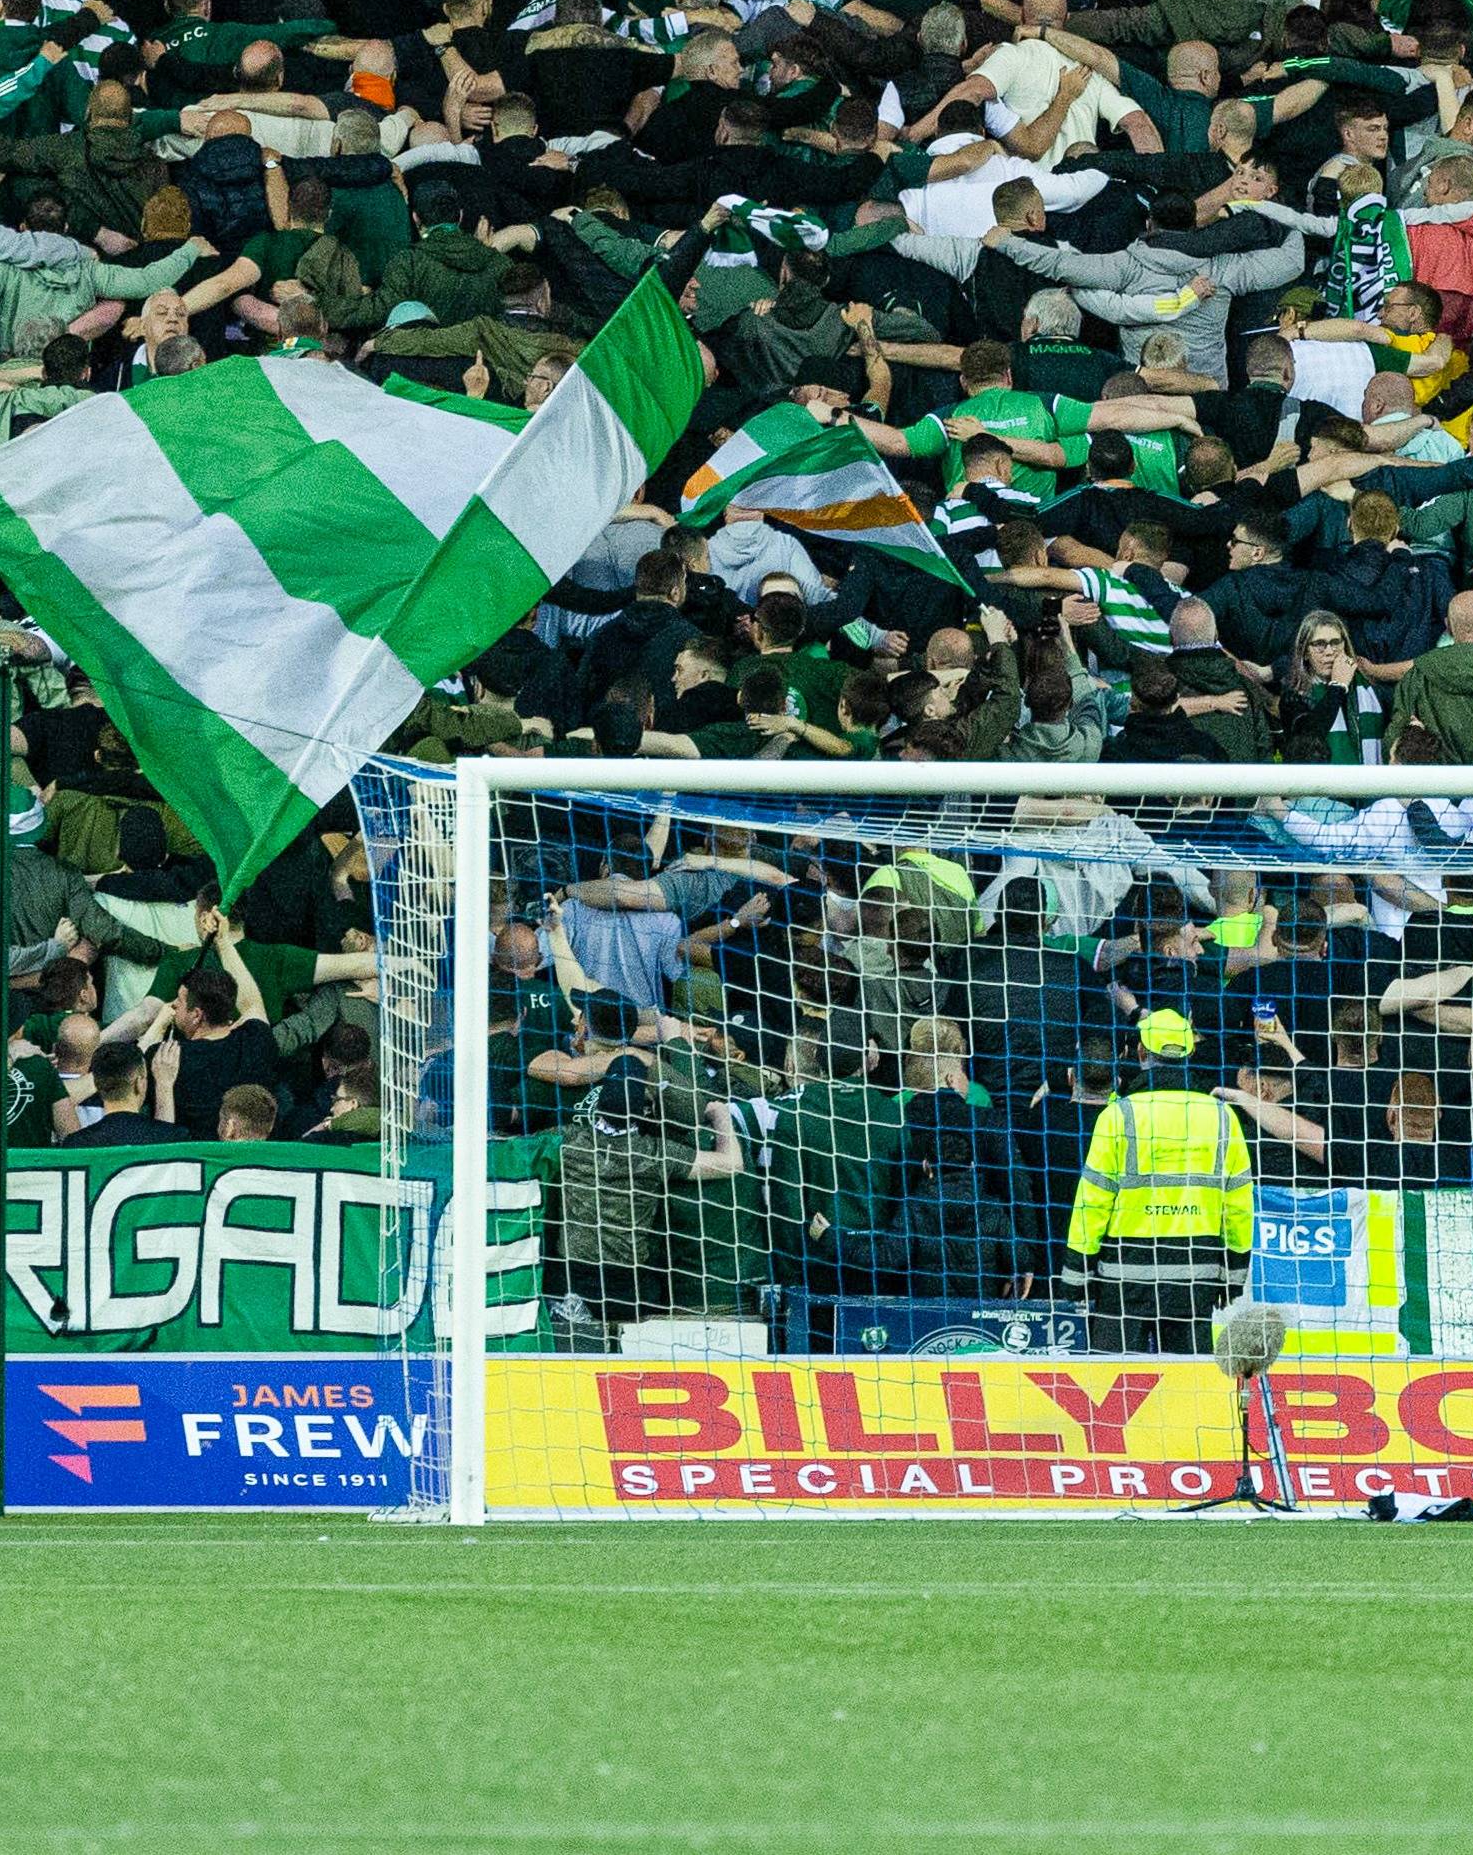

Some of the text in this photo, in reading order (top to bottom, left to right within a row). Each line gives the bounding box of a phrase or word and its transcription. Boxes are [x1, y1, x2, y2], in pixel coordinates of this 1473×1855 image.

[1029, 343, 1092, 356] MAGNERS
[1260, 1222, 1336, 1255] PIGS
[1040, 1320, 1076, 1346] 12
[232, 1384, 375, 1409] JAMES
[595, 1371, 1163, 1455] BILLY
[181, 1414, 428, 1460] FREW
[243, 1473, 388, 1487] SINCE 1911
[621, 1463, 997, 1497] SPECIAL
